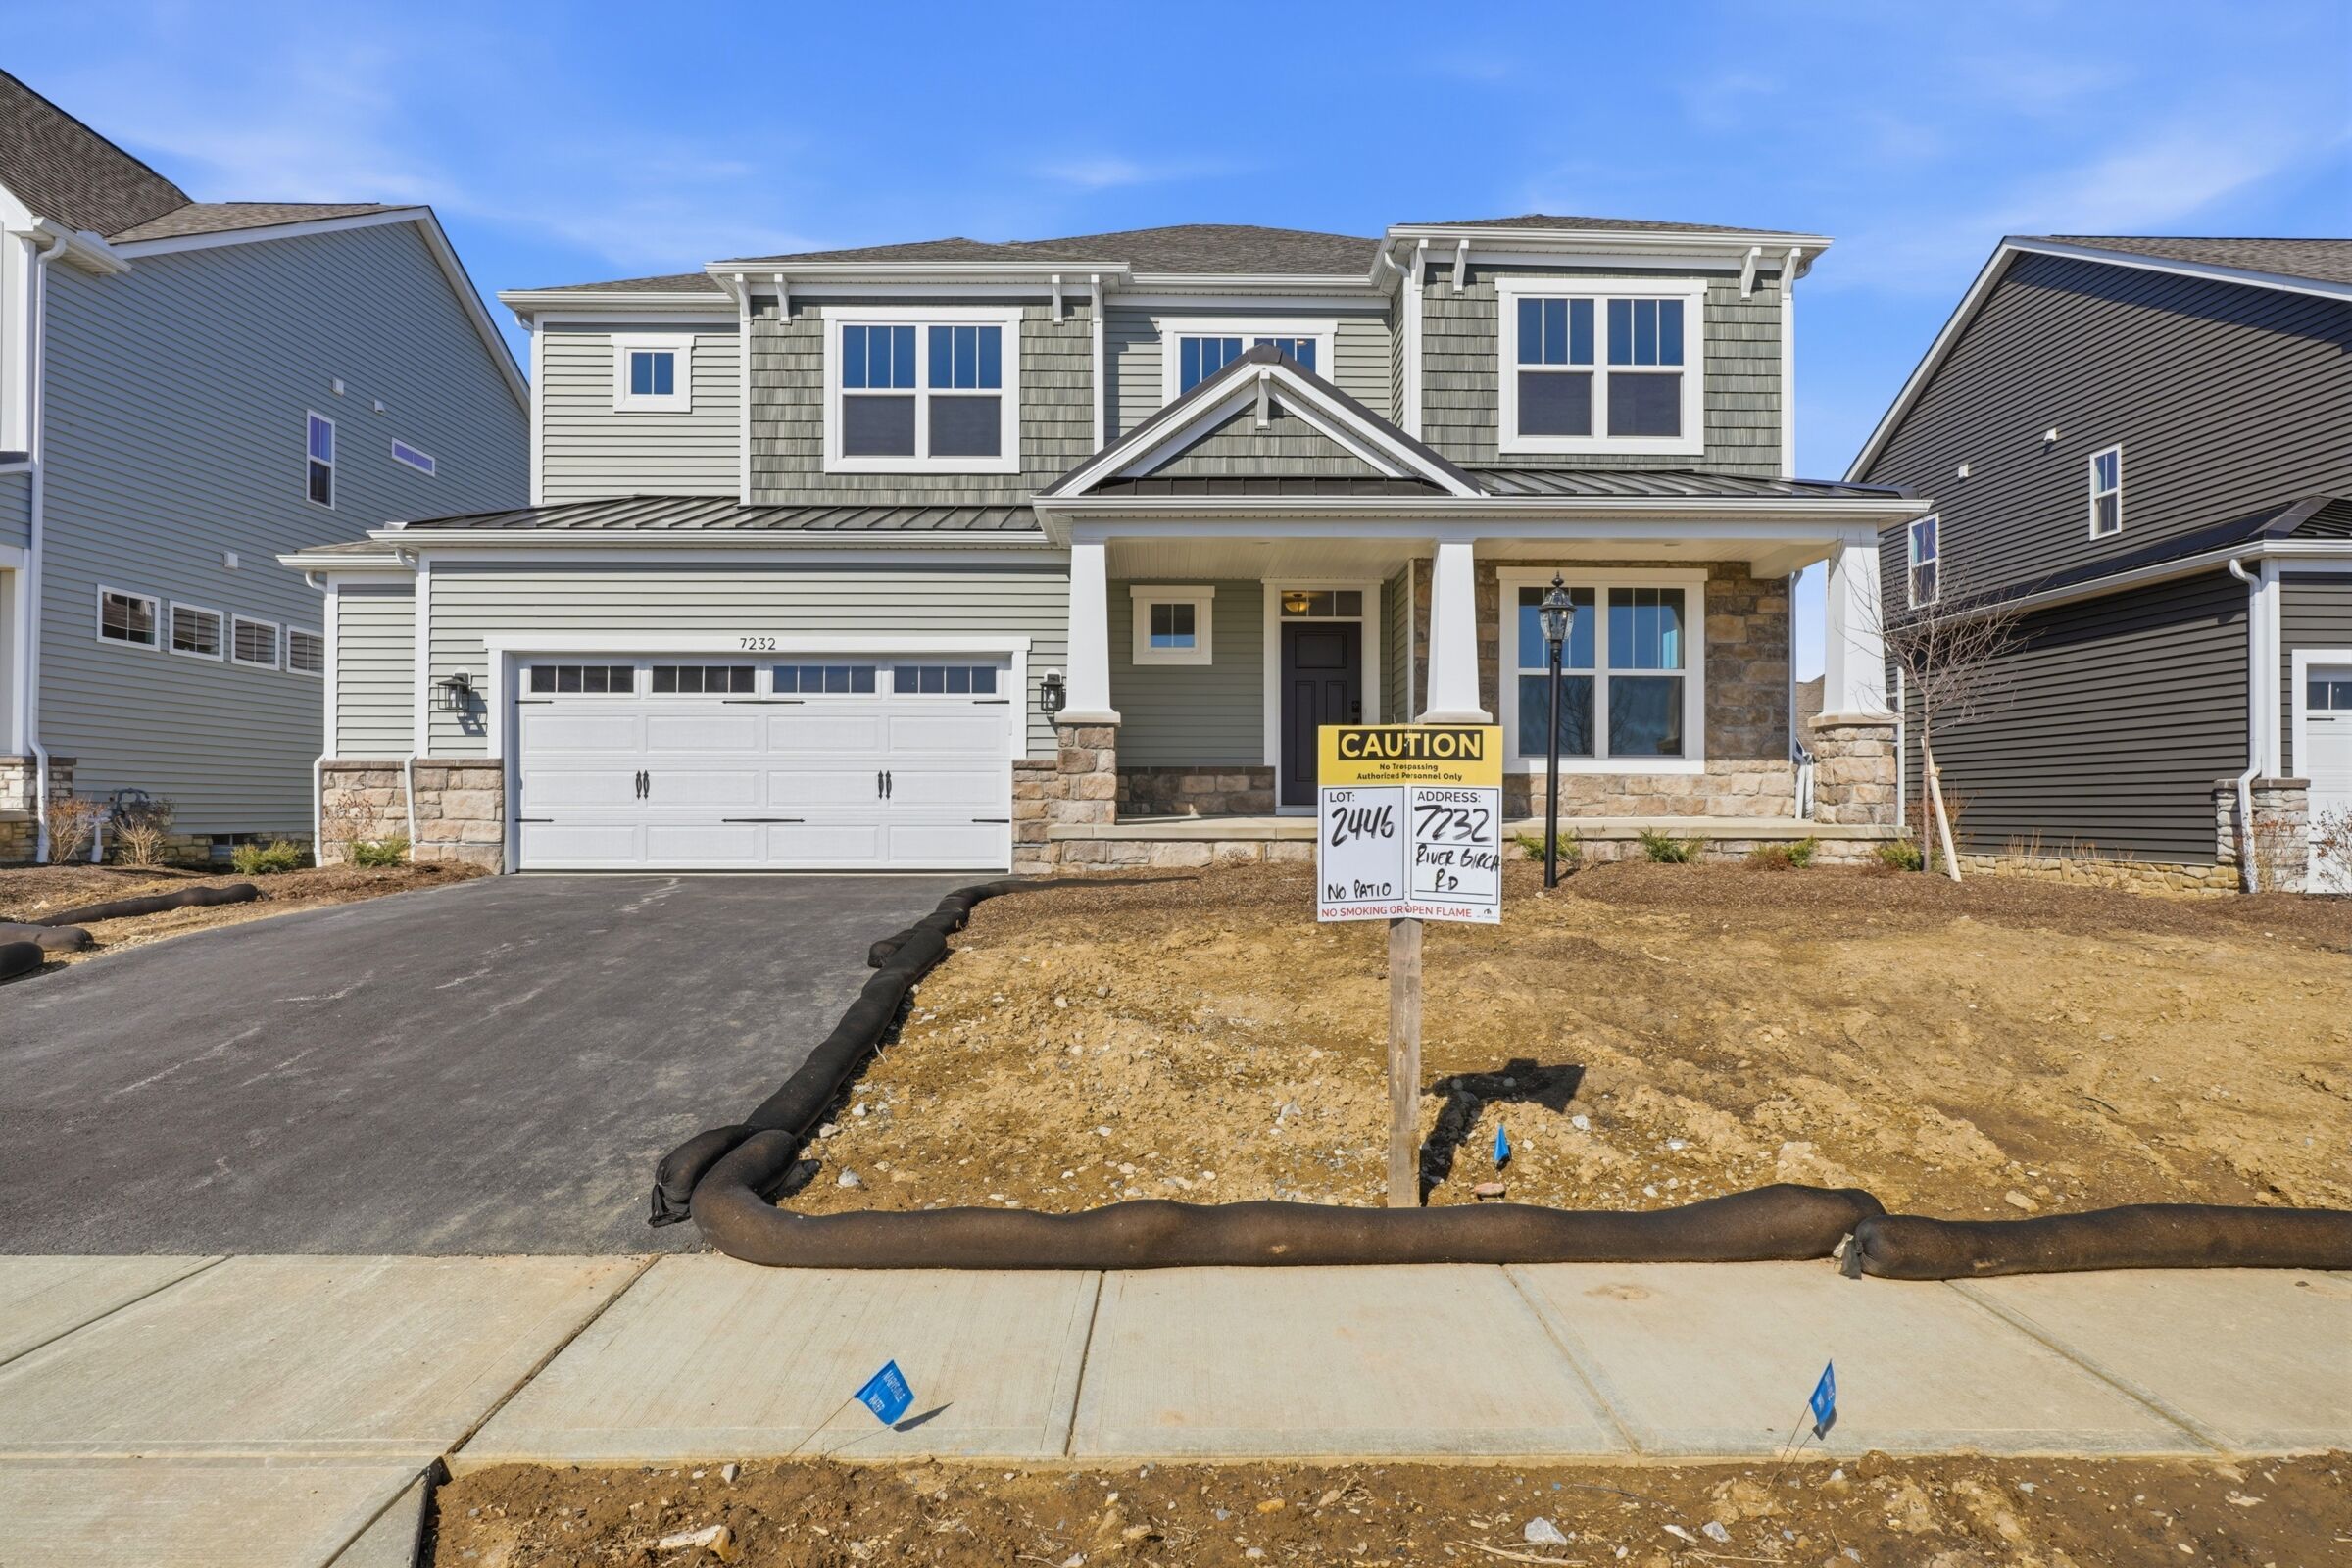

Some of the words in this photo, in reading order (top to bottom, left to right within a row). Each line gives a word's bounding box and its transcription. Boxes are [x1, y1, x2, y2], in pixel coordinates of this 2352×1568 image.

[740, 637, 776, 650] 7232
[1341, 733, 1481, 758] CAUTION
[1444, 772, 1462, 782] Only
[1329, 791, 1355, 803] LOT:
[1417, 791, 1481, 803] ADDRESS:
[1331, 805, 1395, 847] 2446
[1414, 804, 1492, 843] 7232
[1435, 868, 1458, 892] RD
[1353, 879, 1392, 899] PATIO
[1322, 908, 1337, 917] NO
[1340, 906, 1387, 917] SMOKING
[1389, 906, 1403, 914] OR
[1405, 906, 1433, 915] OPEN
[1436, 906, 1472, 917] FLAME
